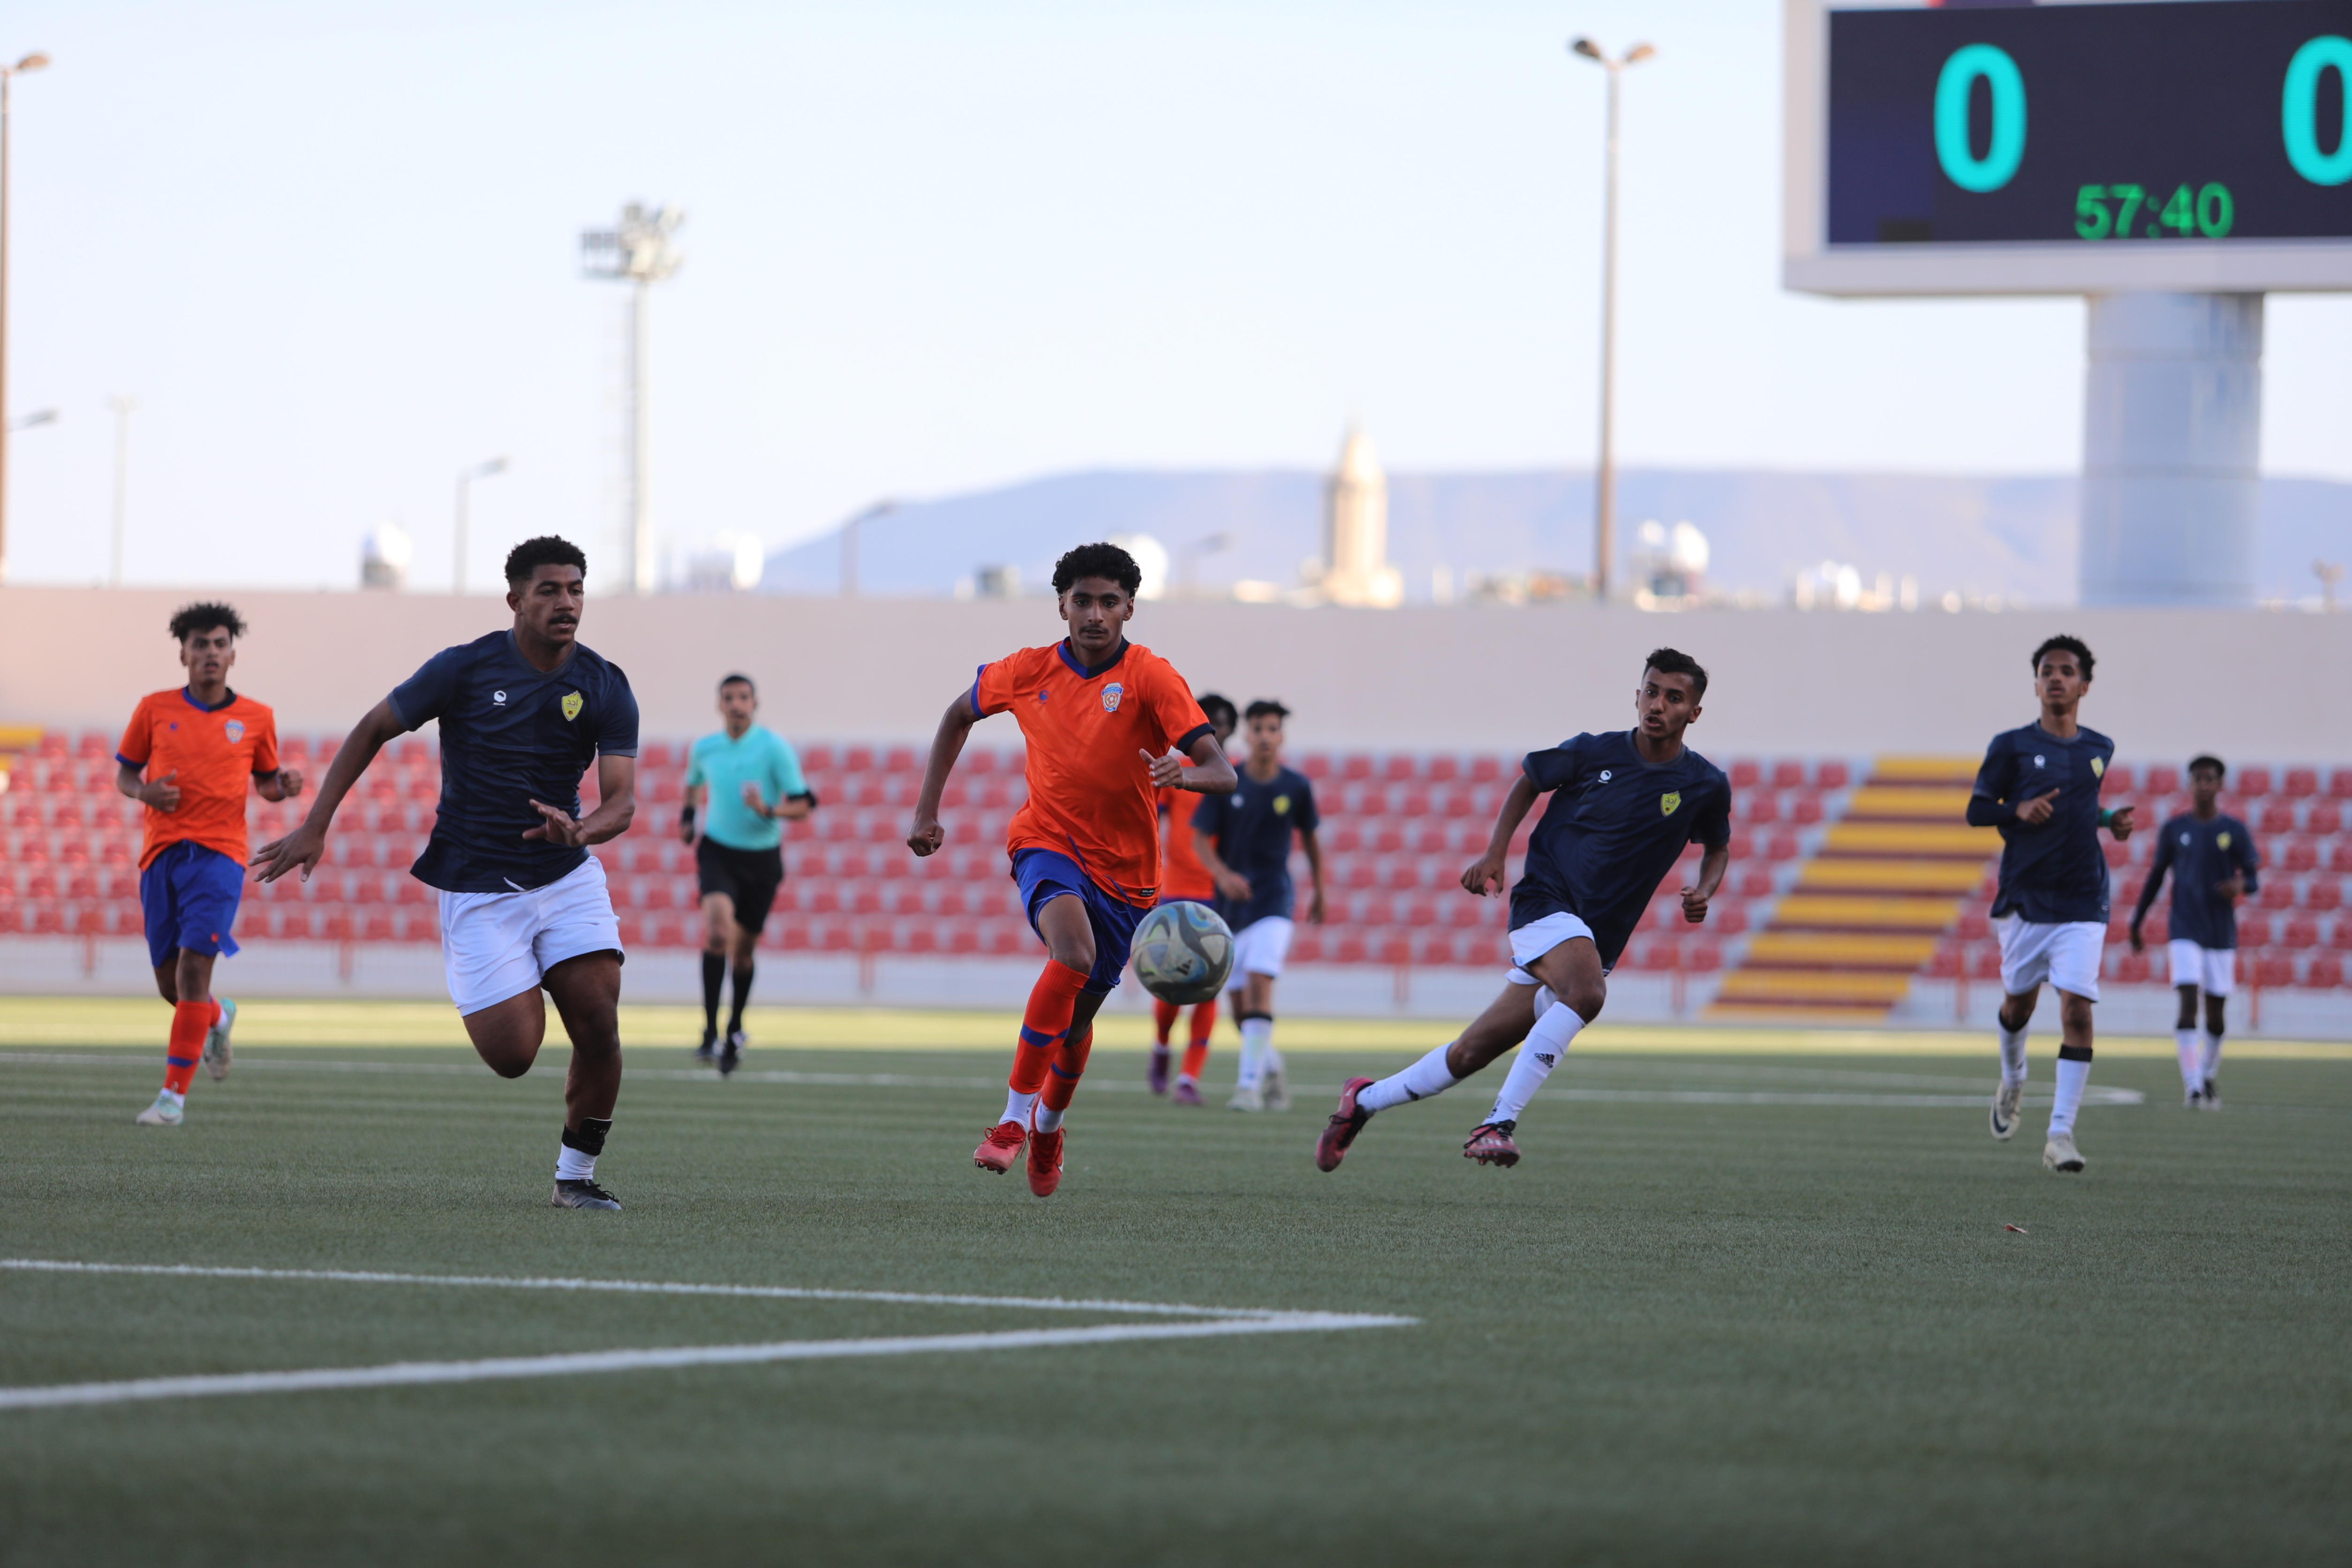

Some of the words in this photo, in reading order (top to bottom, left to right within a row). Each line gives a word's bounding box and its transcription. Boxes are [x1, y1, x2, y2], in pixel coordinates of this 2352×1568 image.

[1934, 43, 2027, 193] 0
[2282, 35, 2352, 186] 0
[2074, 182, 2234, 241] 57:40
